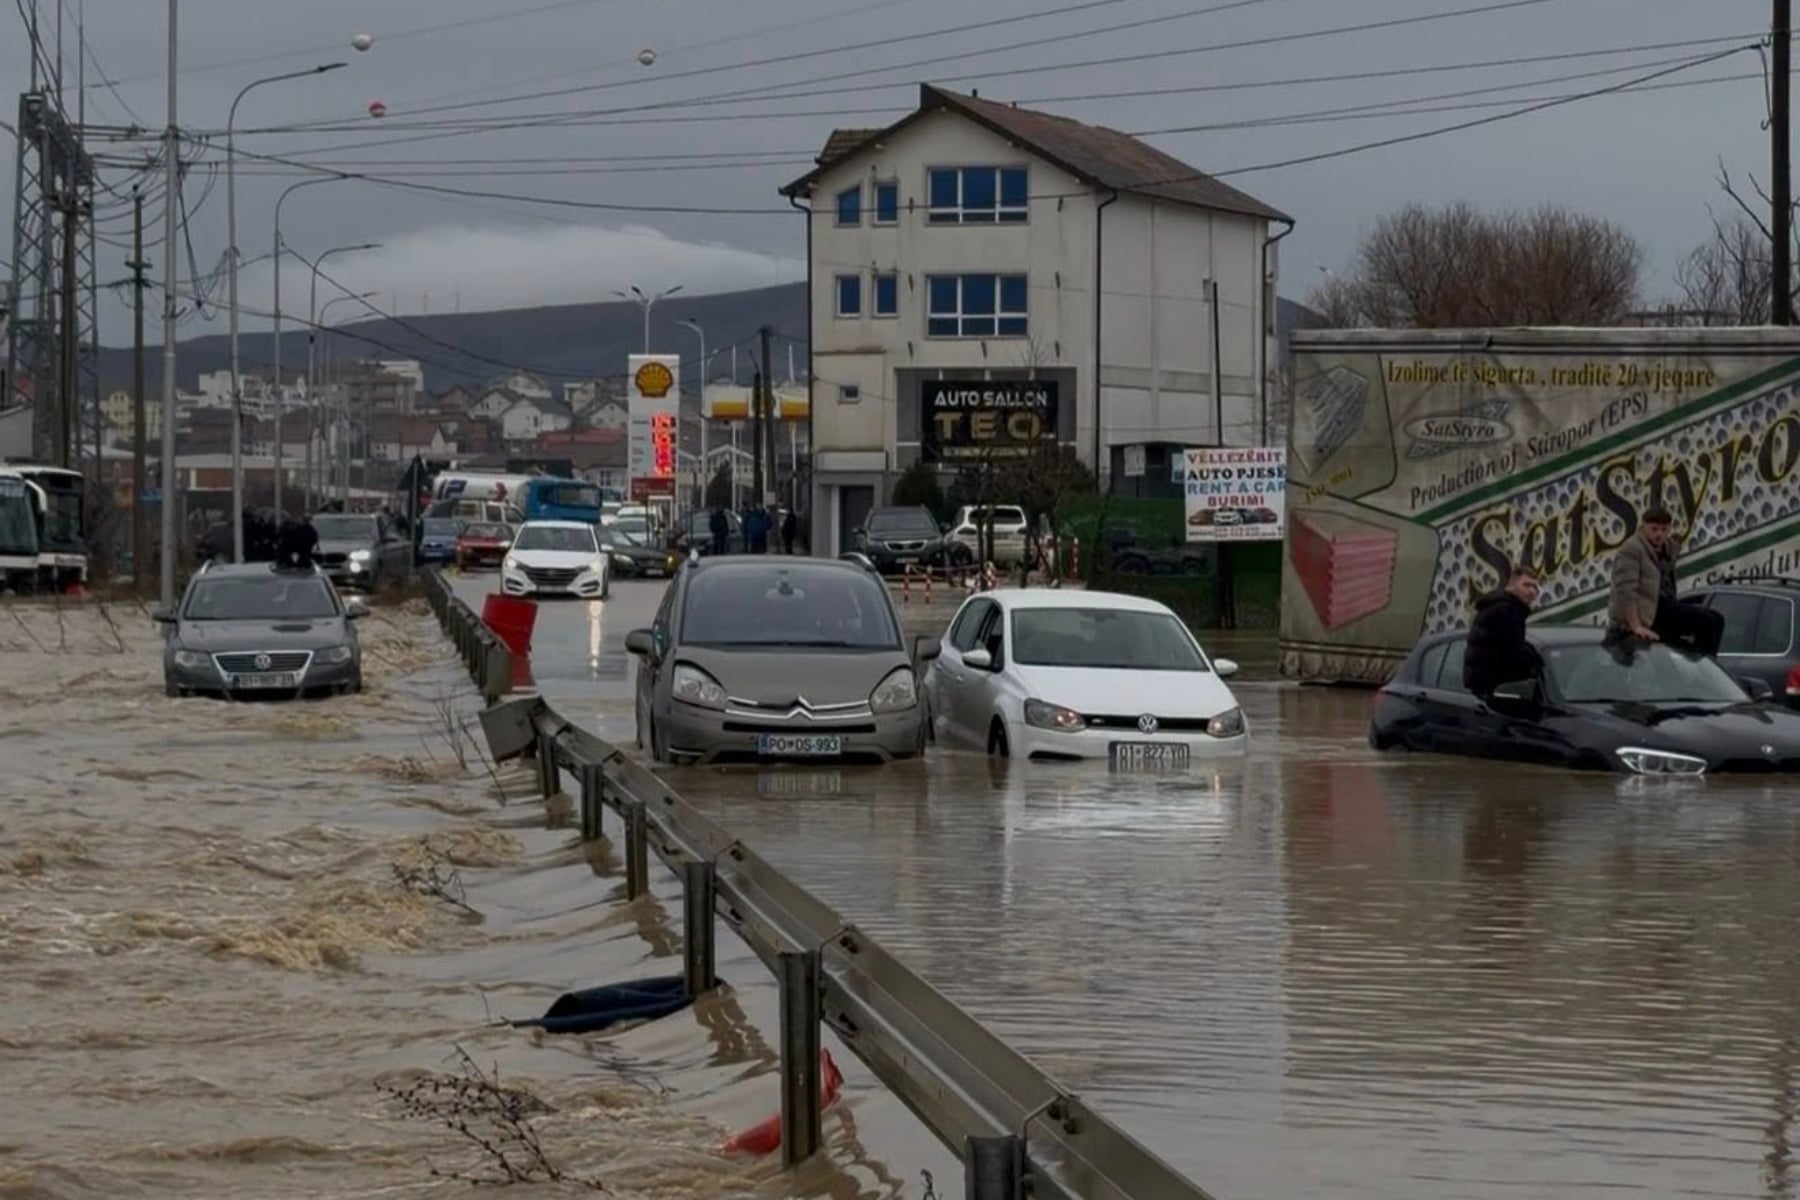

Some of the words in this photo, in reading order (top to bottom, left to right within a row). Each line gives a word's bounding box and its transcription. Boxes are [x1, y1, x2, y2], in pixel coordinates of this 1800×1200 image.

[1616, 364, 1637, 386] 20
[933, 390, 980, 407] AUTO
[982, 390, 1049, 407] SALLON
[933, 411, 1043, 442] TEO
[1421, 420, 1495, 441] SatStyro
[1410, 459, 1496, 509] Production
[1500, 443, 1518, 475] of
[1601, 391, 1645, 433] (EPS)
[1187, 468, 1232, 480] AUTO
[1187, 482, 1232, 495] RENT
[1238, 482, 1249, 493] A
[1207, 495, 1264, 507] BURIMI
